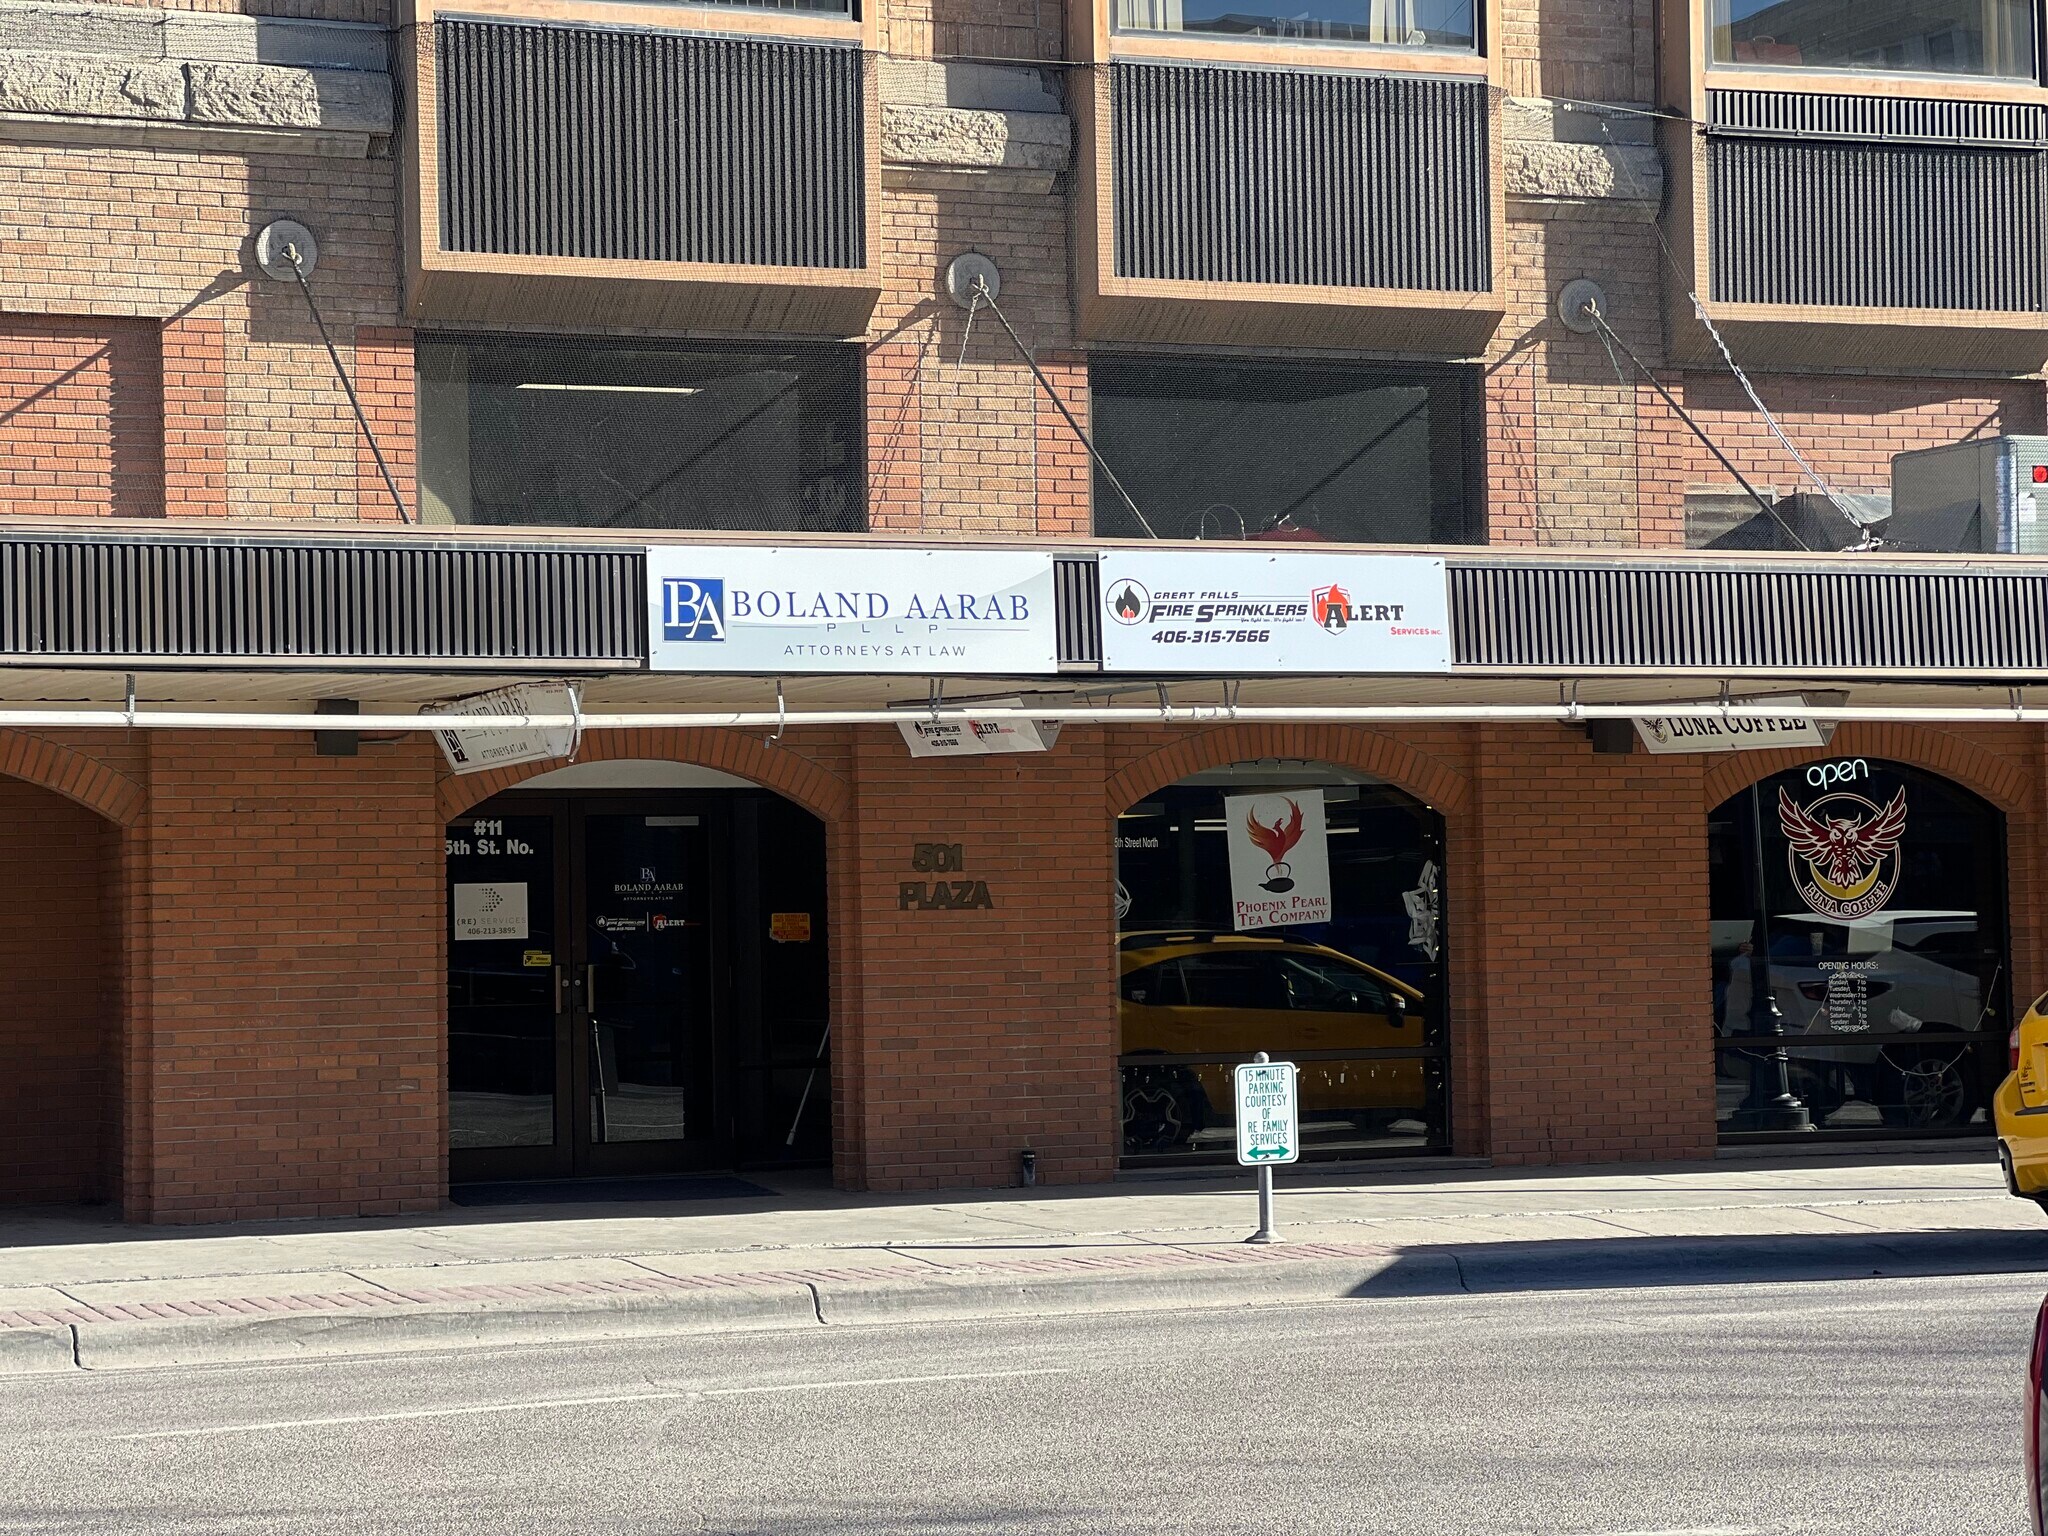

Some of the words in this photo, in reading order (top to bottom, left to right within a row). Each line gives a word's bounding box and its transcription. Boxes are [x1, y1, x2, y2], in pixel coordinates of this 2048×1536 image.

[1153, 591, 1195, 599] GREAT
[1200, 591, 1239, 599] FALLS
[731, 591, 889, 619] BOLAND
[905, 594, 1030, 621] AARAB
[1149, 604, 1194, 623] FIRE
[1195, 604, 1308, 623] SPRINKLERS
[1324, 603, 1404, 628] ALERT
[1151, 630, 1270, 643] 406-315-7666
[1390, 626, 1430, 636] SERVICES
[784, 644, 894, 657] ATTORNEYS
[900, 645, 922, 657] AT
[928, 645, 967, 657] LAW
[1666, 717, 1723, 737] LUNA
[1806, 759, 1869, 790] open
[474, 820, 502, 836] #11
[446, 839, 470, 855] 5th
[477, 839, 500, 855] St.
[506, 839, 534, 855] No.
[1114, 836, 1123, 848] 5th
[1124, 836, 1142, 848] Street
[1142, 836, 1158, 848] North
[912, 844, 962, 873] 501
[614, 884, 651, 892] BOLAND
[654, 883, 684, 891] AARAB
[899, 881, 993, 910] PLAZA
[1803, 881, 1838, 913] LUNA
[1840, 880, 1889, 915] COFFEE
[1236, 901, 1287, 914] PHOENIX
[1292, 896, 1328, 909] PEARL
[456, 918, 477, 926] (RE)
[480, 917, 527, 925] SERVICES
[656, 919, 685, 930] ALERT
[1238, 913, 1263, 927] TEA
[1269, 909, 1327, 924] COMPANY
[467, 926, 516, 935] 406-213-3895
[1818, 961, 1849, 970] OPENING
[1851, 961, 1879, 970] HOURS:
[1245, 1070, 1254, 1082] 15
[1255, 1068, 1285, 1081] MINUTE
[1249, 1081, 1284, 1094] PARKING
[1245, 1094, 1287, 1107] COURTESY
[1262, 1108, 1271, 1119] OF
[1248, 1121, 1257, 1133] RE
[1262, 1119, 1288, 1132] FAMILY
[1250, 1132, 1288, 1146] SERVICES
